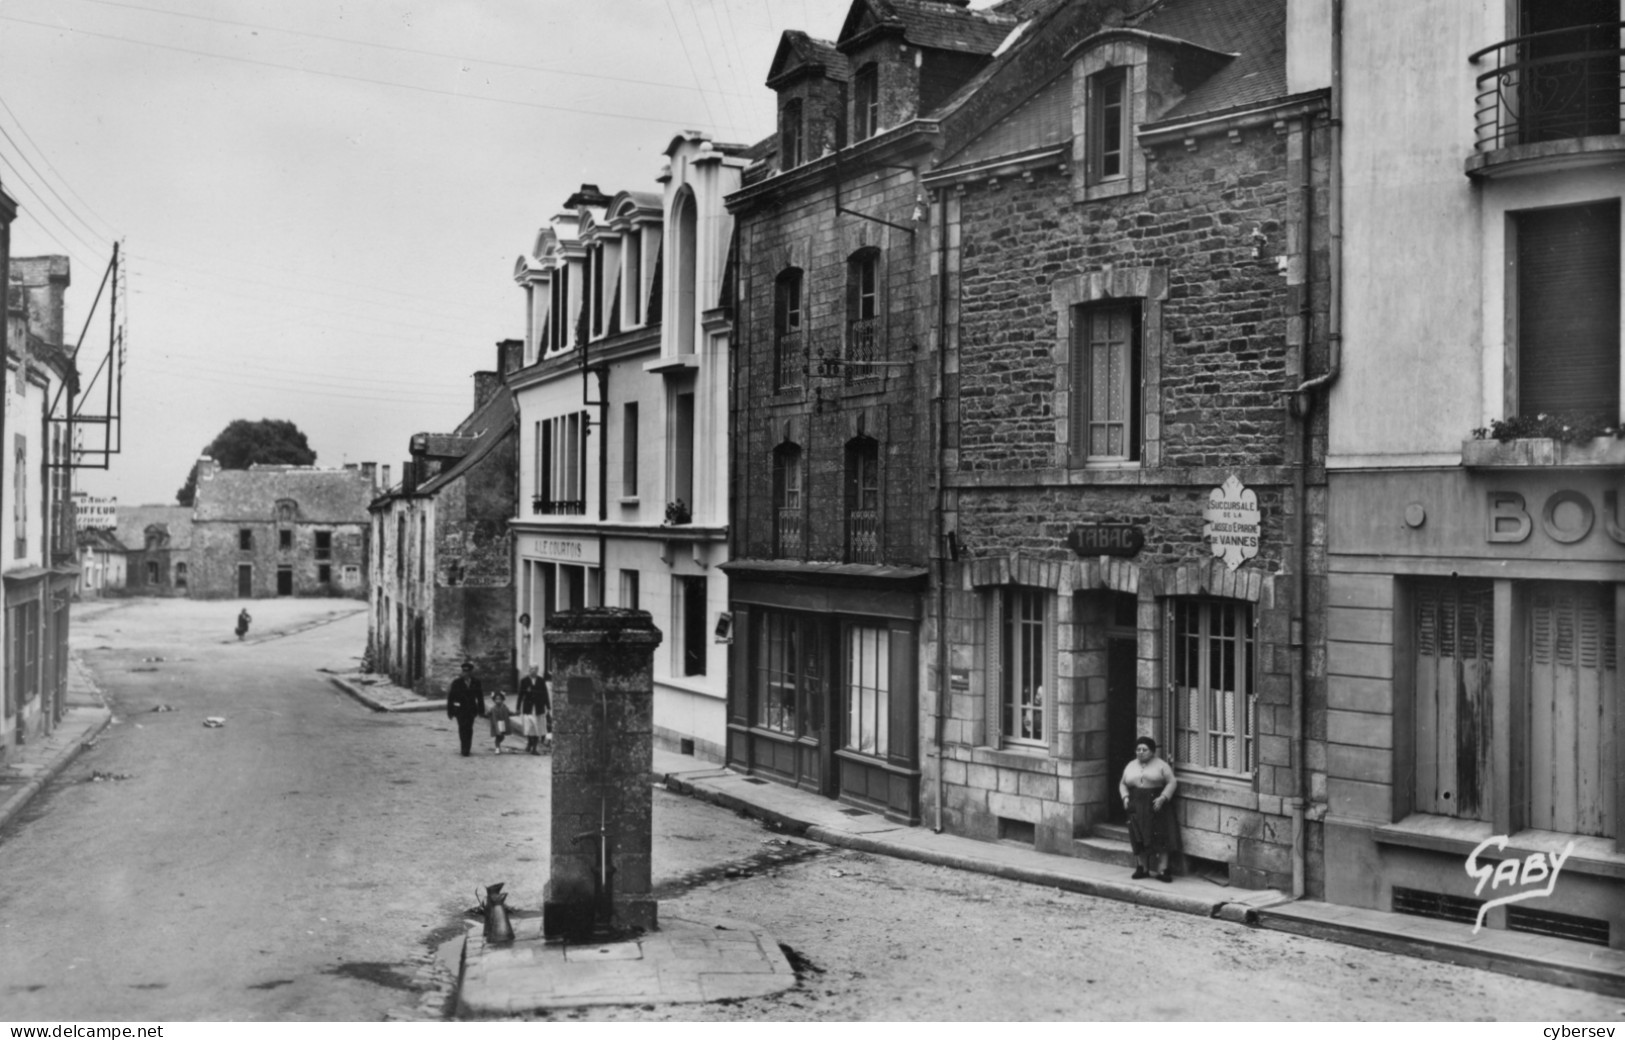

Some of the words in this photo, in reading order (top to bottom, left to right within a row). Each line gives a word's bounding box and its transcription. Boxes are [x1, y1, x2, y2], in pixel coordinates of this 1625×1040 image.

[1210, 500, 1255, 511] SUCCURSALE
[1485, 489, 1625, 545] BOU
[1076, 528, 1133, 548] TABAC
[1219, 535, 1257, 547] VANNES
